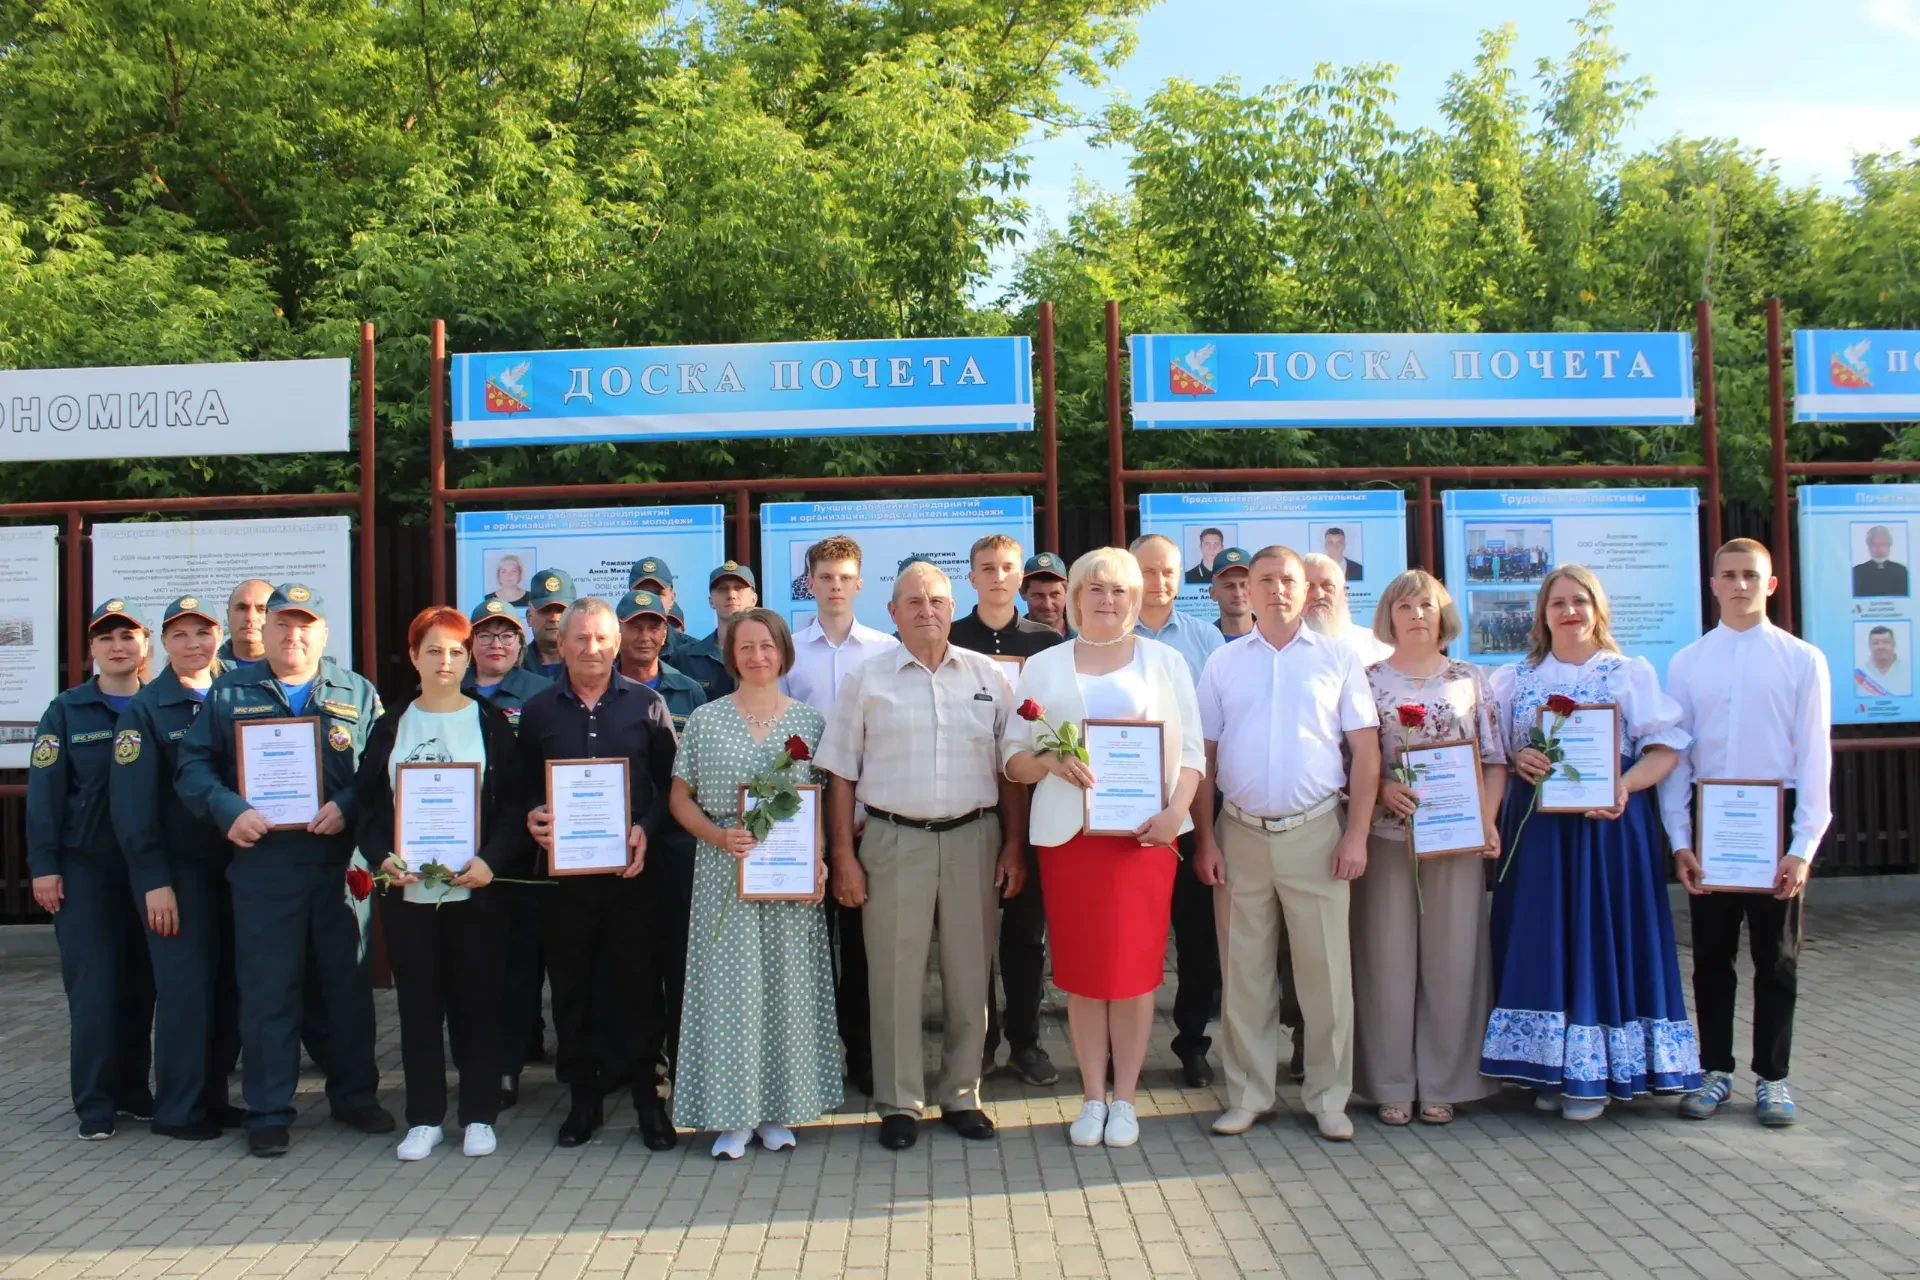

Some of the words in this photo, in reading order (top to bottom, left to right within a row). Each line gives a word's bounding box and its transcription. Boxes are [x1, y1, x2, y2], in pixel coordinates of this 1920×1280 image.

[1249, 349, 1428, 388] ДОСКА
[1451, 349, 1656, 380] ПОЧЕТА
[1887, 349, 1920, 373] П
[564, 362, 745, 405] ДОСКА
[771, 355, 987, 391] ПОЧЕТА
[0, 389, 229, 433] НОМИКА
[813, 504, 853, 513] Лучшие
[856, 502, 910, 512] работники
[952, 508, 1004, 517] молодежи
[507, 513, 545, 521] Лучшие
[642, 517, 693, 526] молодежи
